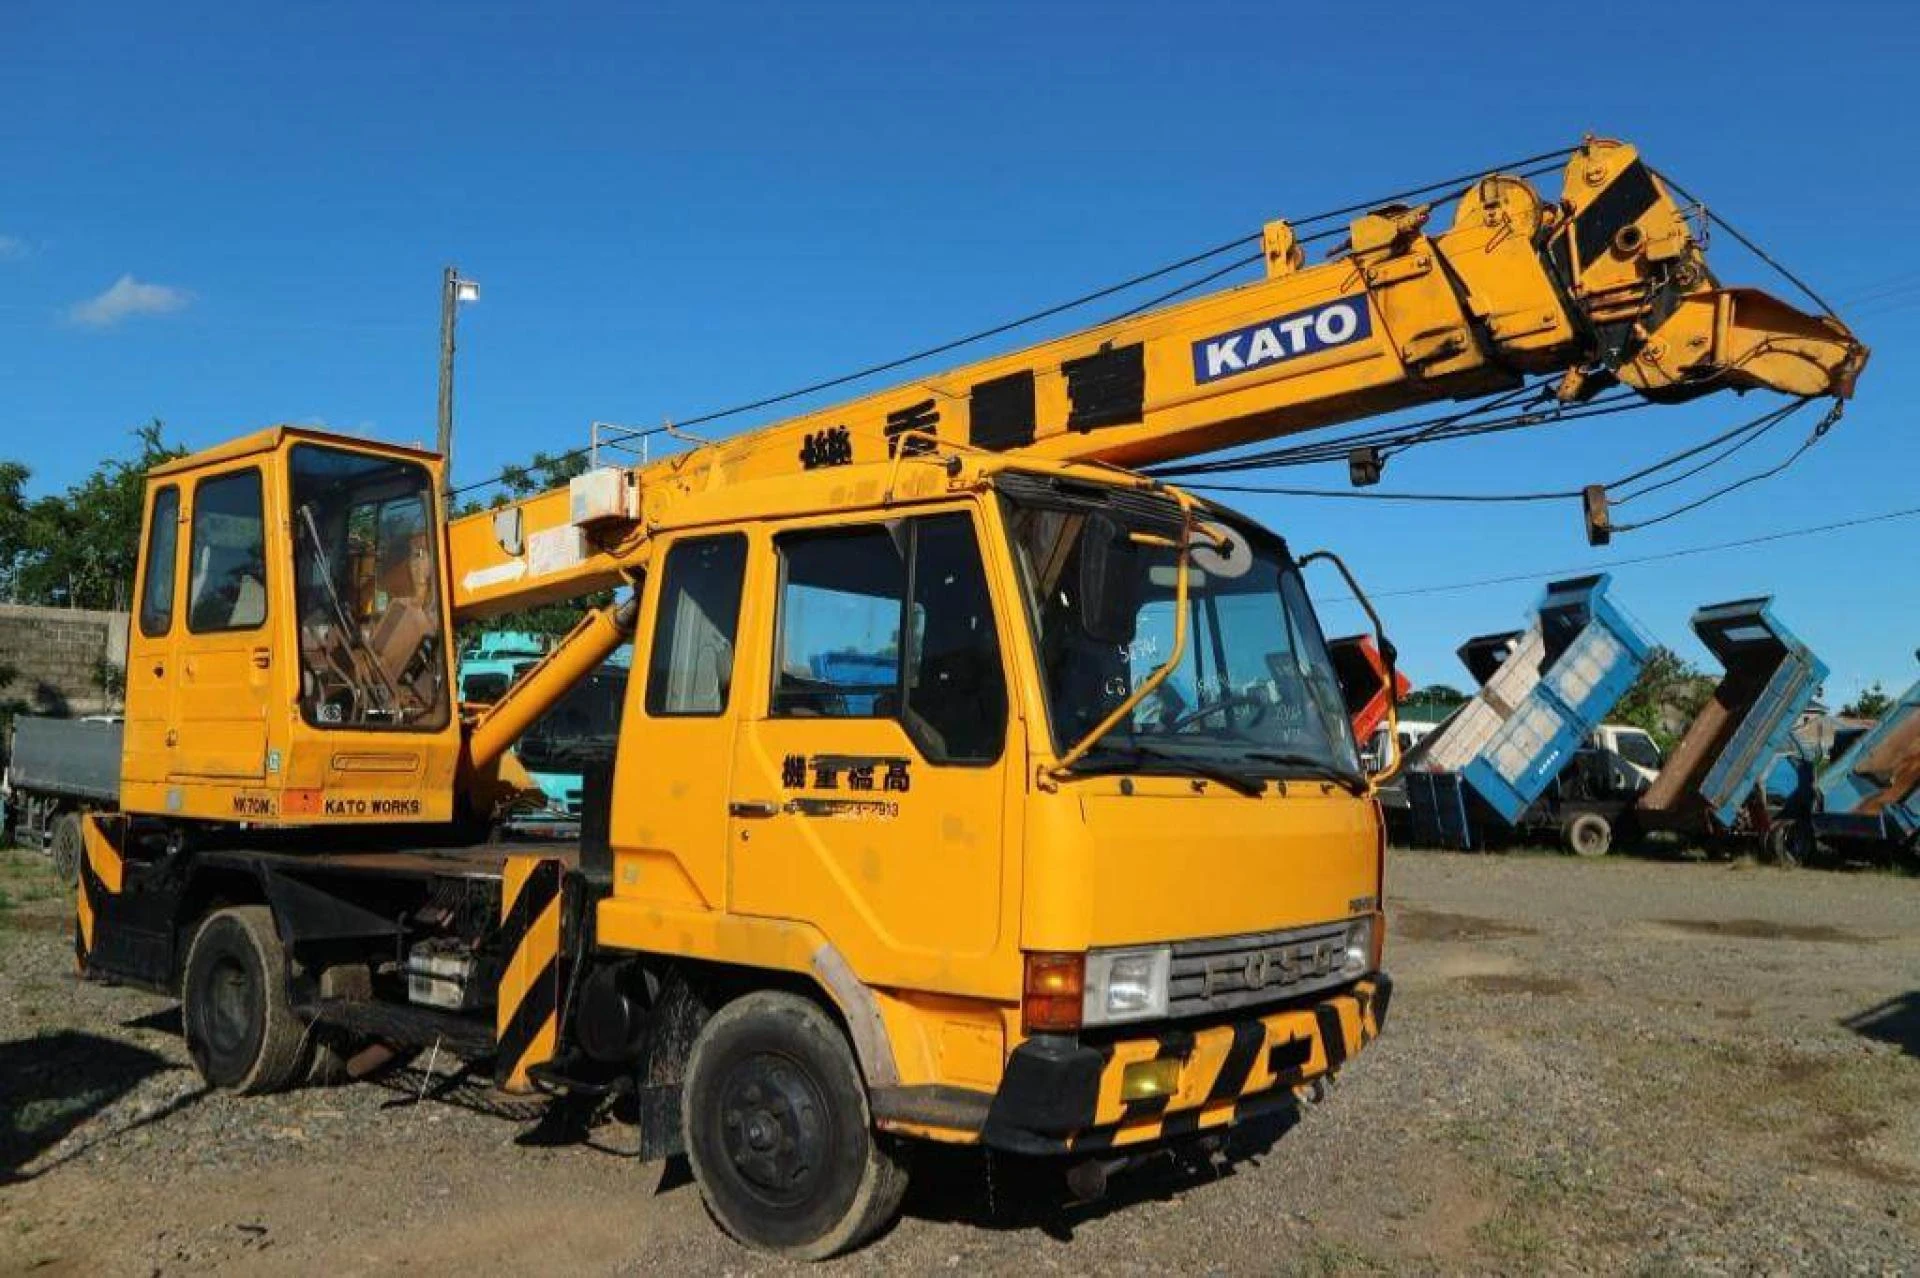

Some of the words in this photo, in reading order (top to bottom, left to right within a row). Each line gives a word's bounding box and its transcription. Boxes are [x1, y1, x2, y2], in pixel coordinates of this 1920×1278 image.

[1205, 303, 1359, 377] KATO
[325, 799, 365, 814] KATO
[371, 799, 420, 815] WORKS
